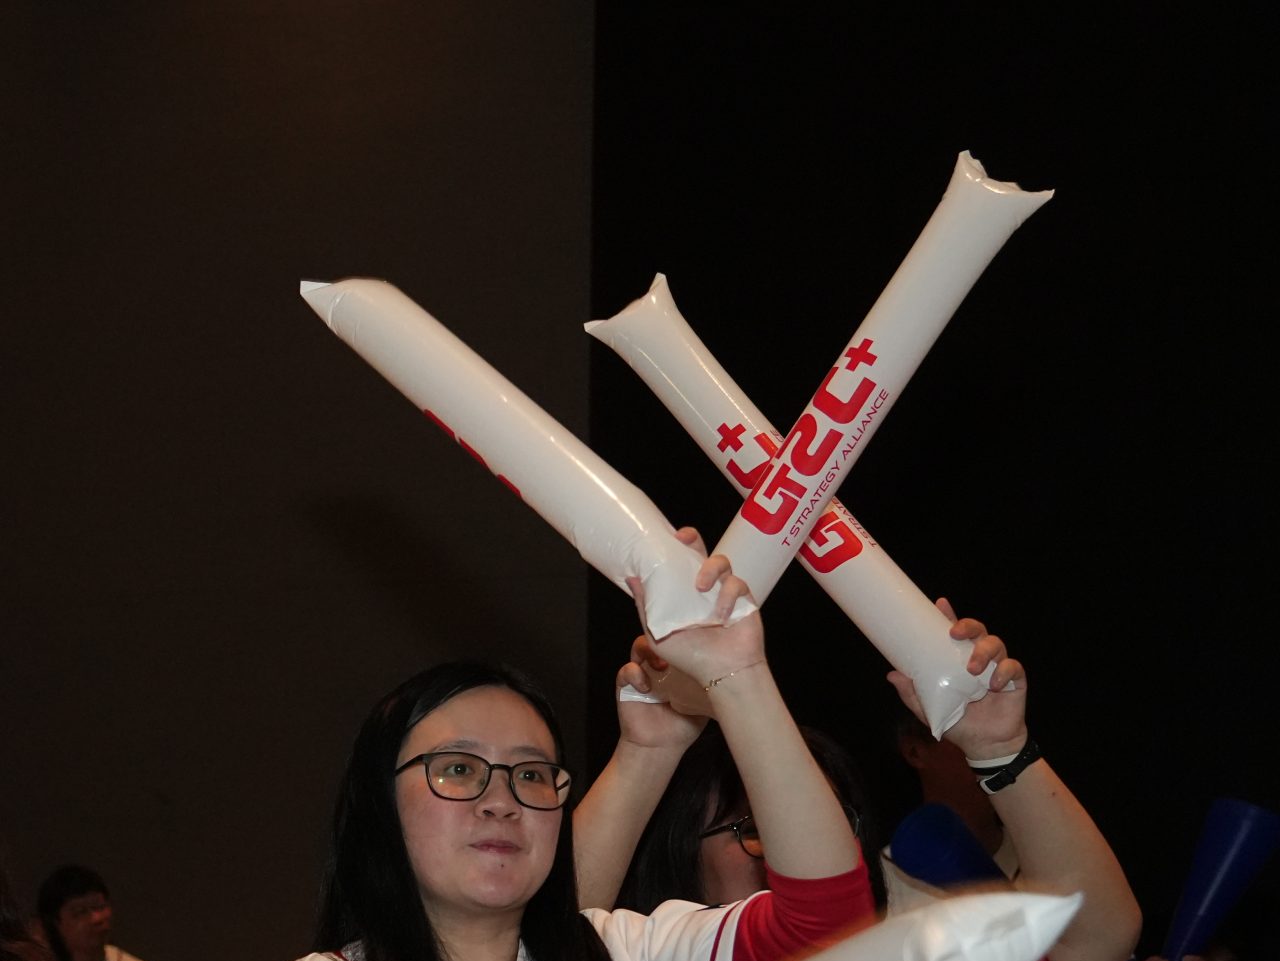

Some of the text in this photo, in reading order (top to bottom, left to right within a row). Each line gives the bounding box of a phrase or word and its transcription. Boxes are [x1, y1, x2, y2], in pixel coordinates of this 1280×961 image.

[781, 388, 890, 548] T STRATEGY ALLIANCE
[831, 497, 869, 539] STRATE
